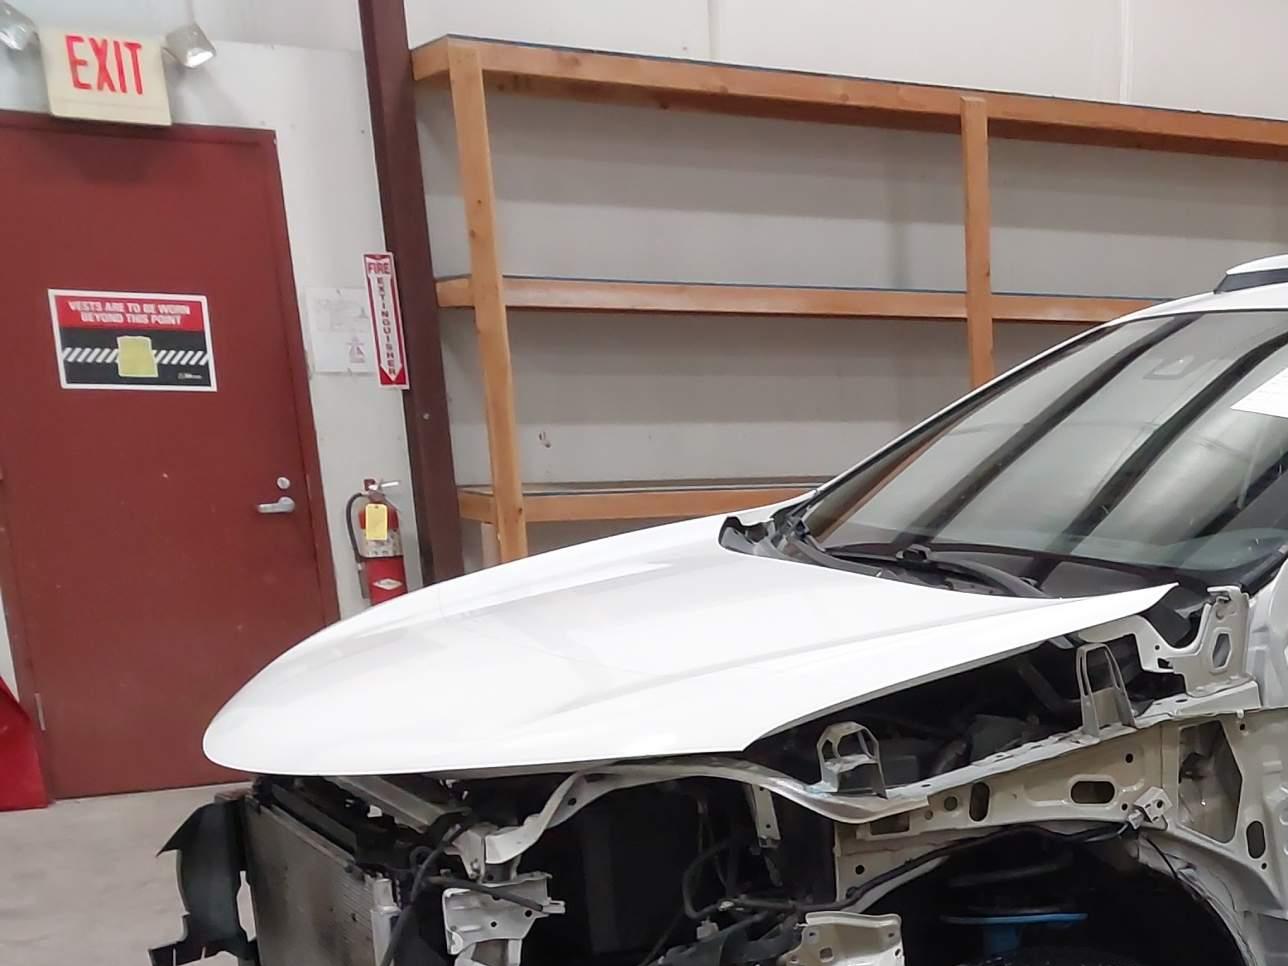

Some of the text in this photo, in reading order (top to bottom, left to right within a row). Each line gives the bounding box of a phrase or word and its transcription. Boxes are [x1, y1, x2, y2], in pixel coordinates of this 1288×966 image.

[65, 34, 145, 96] EXIT
[367, 262, 390, 275] FIRE
[68, 300, 190, 315] VESTS ARE TO BE WORN
[80, 312, 182, 325] BEYOND THIS POINT
[376, 277, 397, 375] EXTINGUISHER
